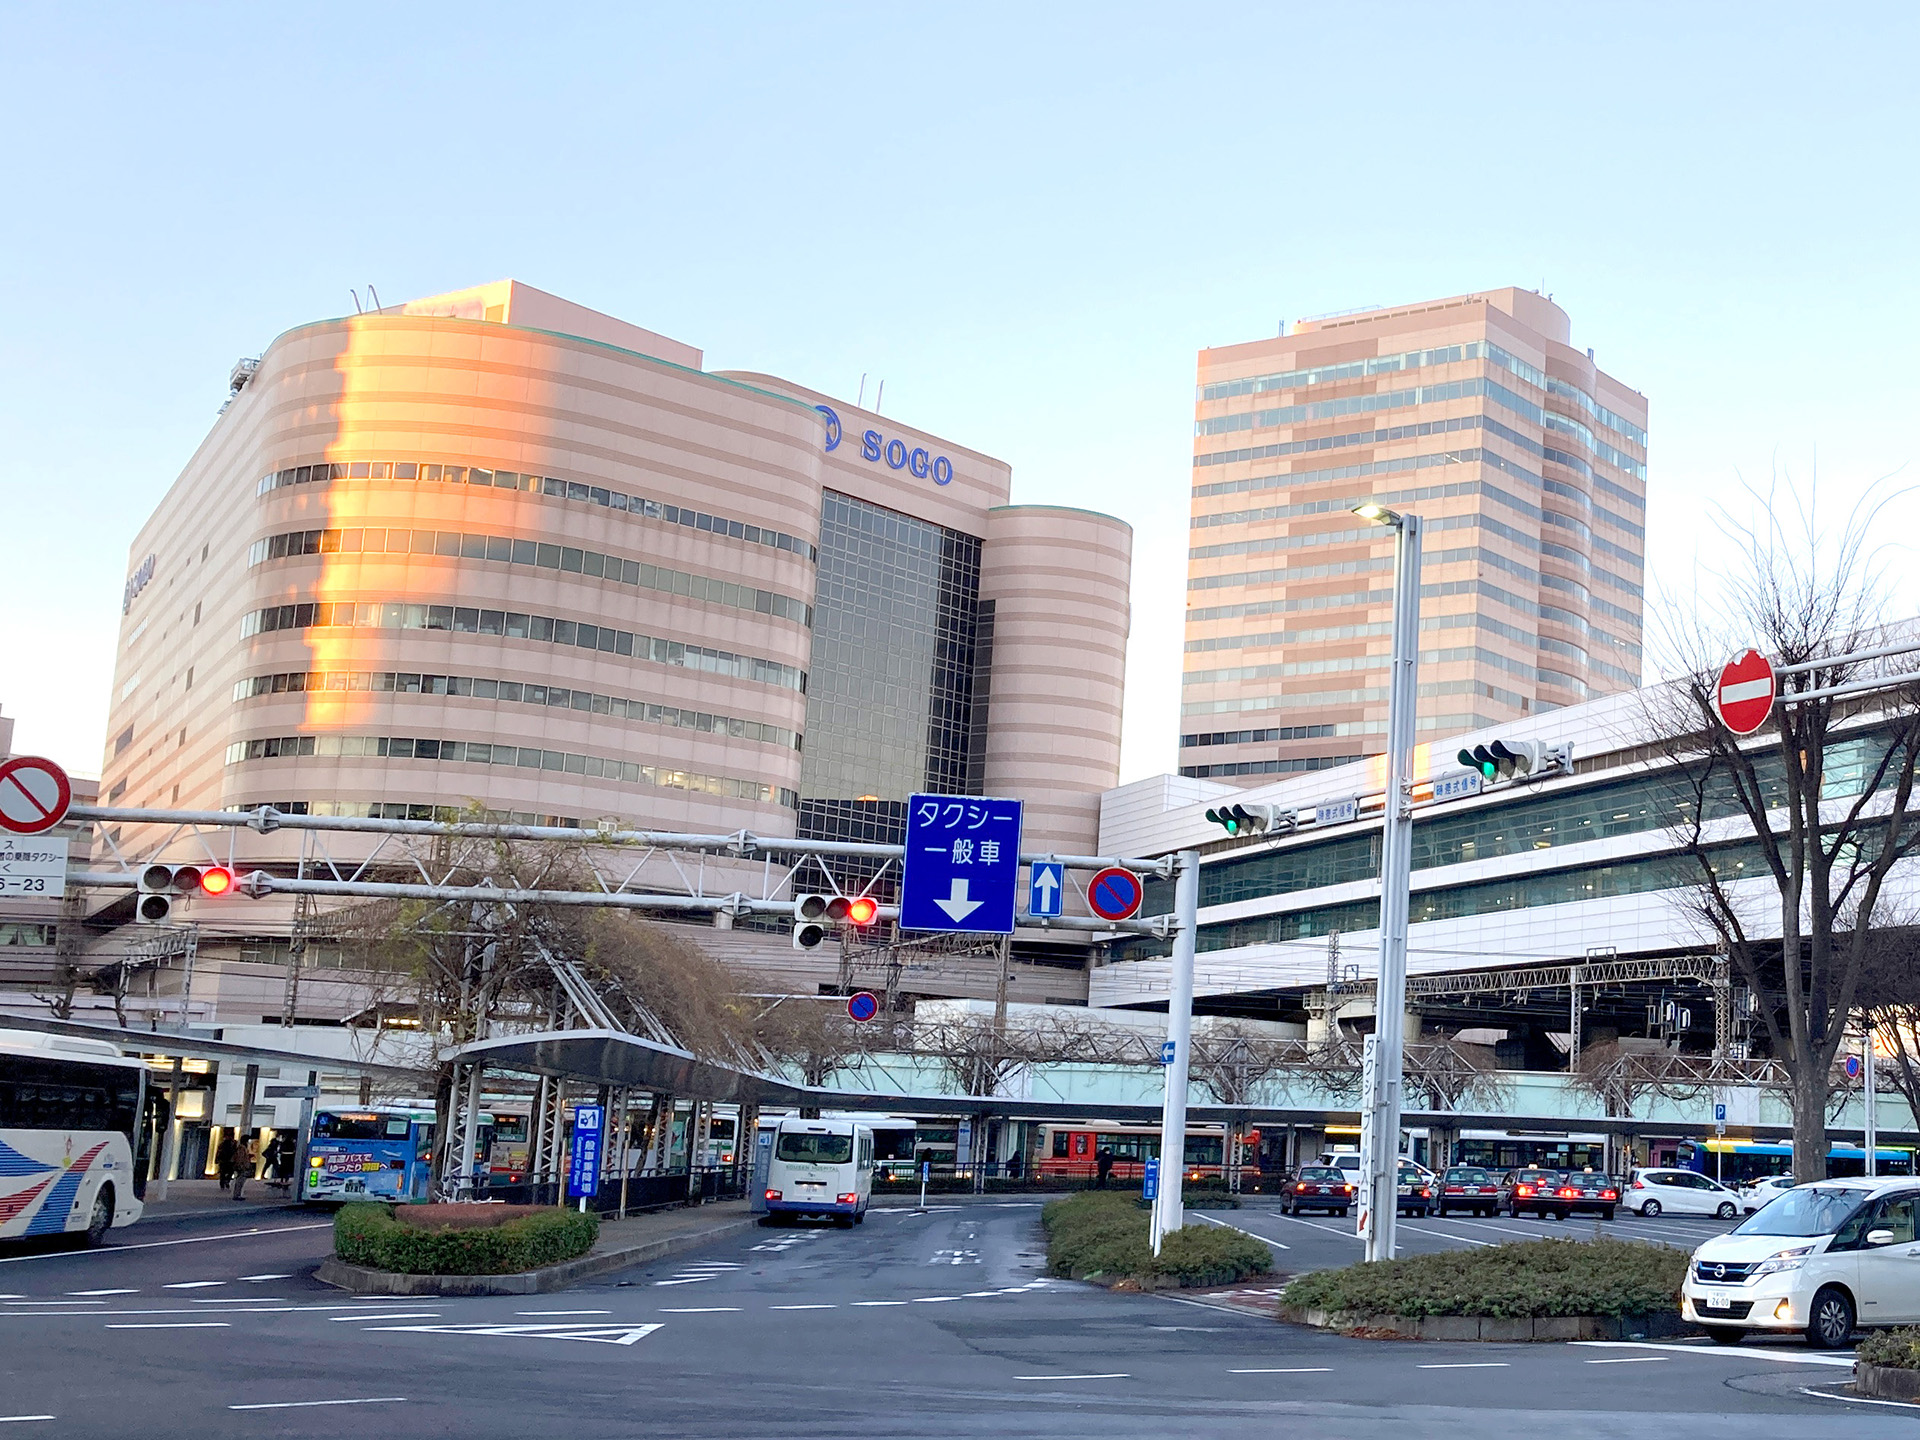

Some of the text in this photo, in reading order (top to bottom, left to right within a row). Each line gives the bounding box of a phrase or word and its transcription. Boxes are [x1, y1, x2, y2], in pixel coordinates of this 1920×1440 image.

[861, 429, 954, 486] SOGO
[917, 802, 1013, 830] タクシー
[924, 837, 1001, 866] 一般車
